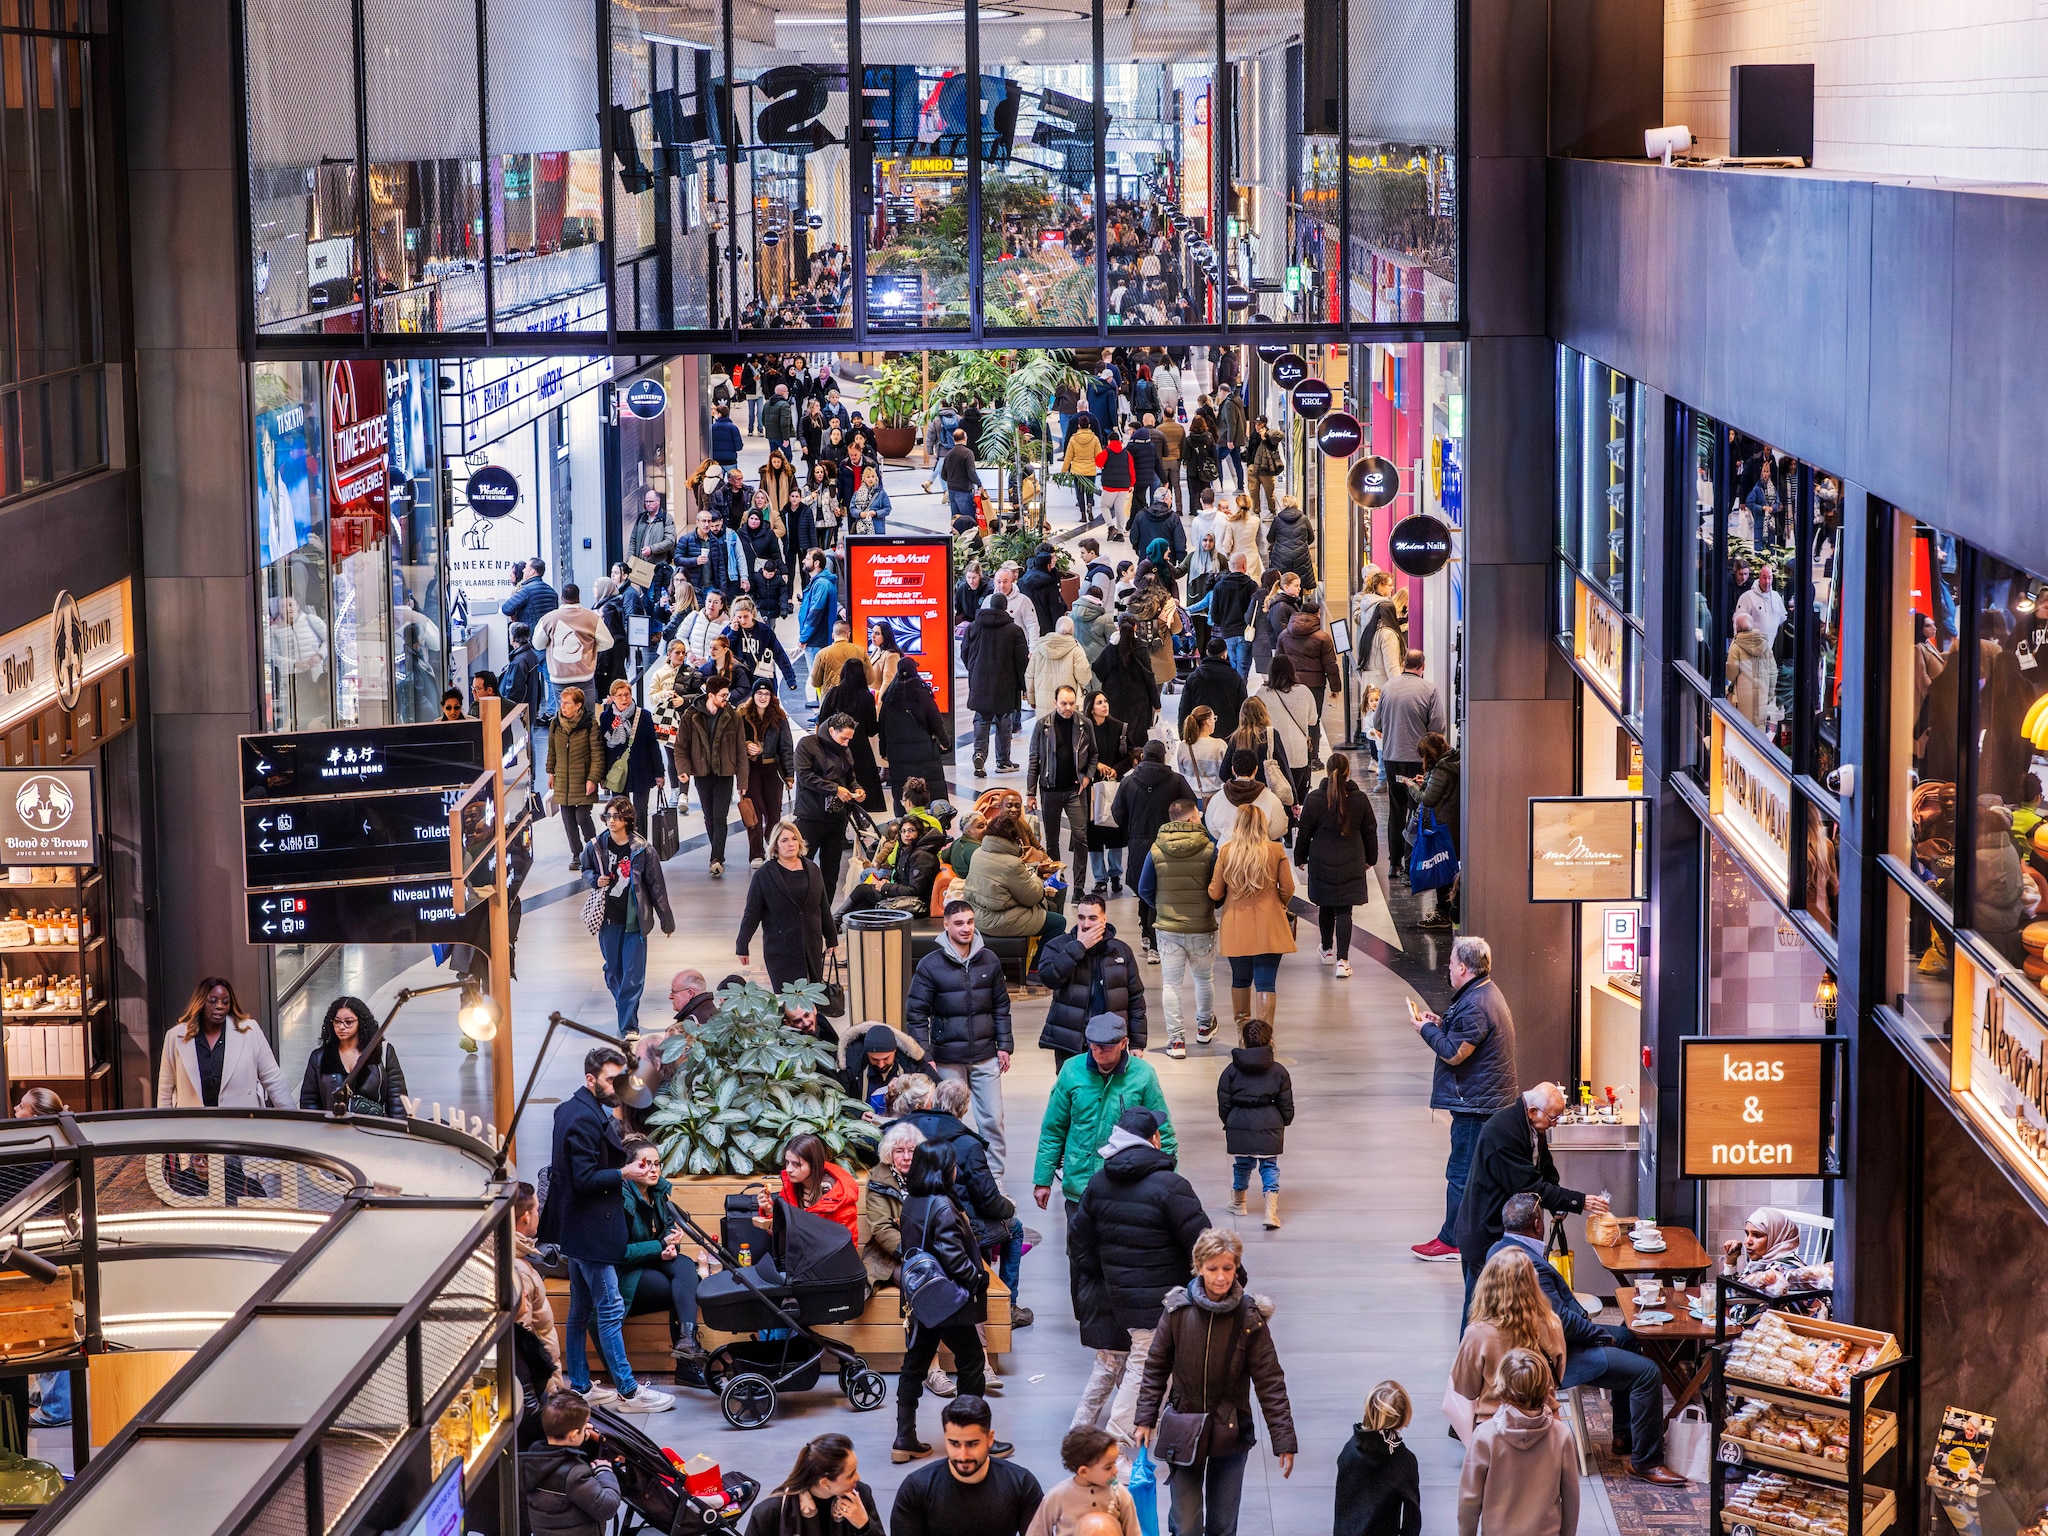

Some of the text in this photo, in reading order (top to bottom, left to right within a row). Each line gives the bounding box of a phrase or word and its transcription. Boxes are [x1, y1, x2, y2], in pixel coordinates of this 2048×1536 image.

[910, 158, 953, 172] JUMBO
[478, 484, 508, 495] Westfield
[1364, 485, 1384, 493] Primera
[1396, 542, 1446, 550] Modern Nails
[880, 577, 903, 585] APPLE
[3, 618, 111, 694] Blond Brown
[327, 747, 375, 766] 華南行
[321, 764, 383, 777] WAH NAM HONG
[5, 837, 88, 849] Blond & Brown
[1422, 851, 1449, 870] ACTION
[393, 888, 429, 901] Niveau
[432, 887, 436, 899] 1
[297, 901, 303, 910] 5
[420, 907, 456, 921] Ingang
[295, 920, 305, 930] 19
[1615, 919, 1627, 933] B
[1723, 1053, 1784, 1081] kaas
[1742, 1096, 1764, 1123] &
[1712, 1139, 1792, 1164] noten
